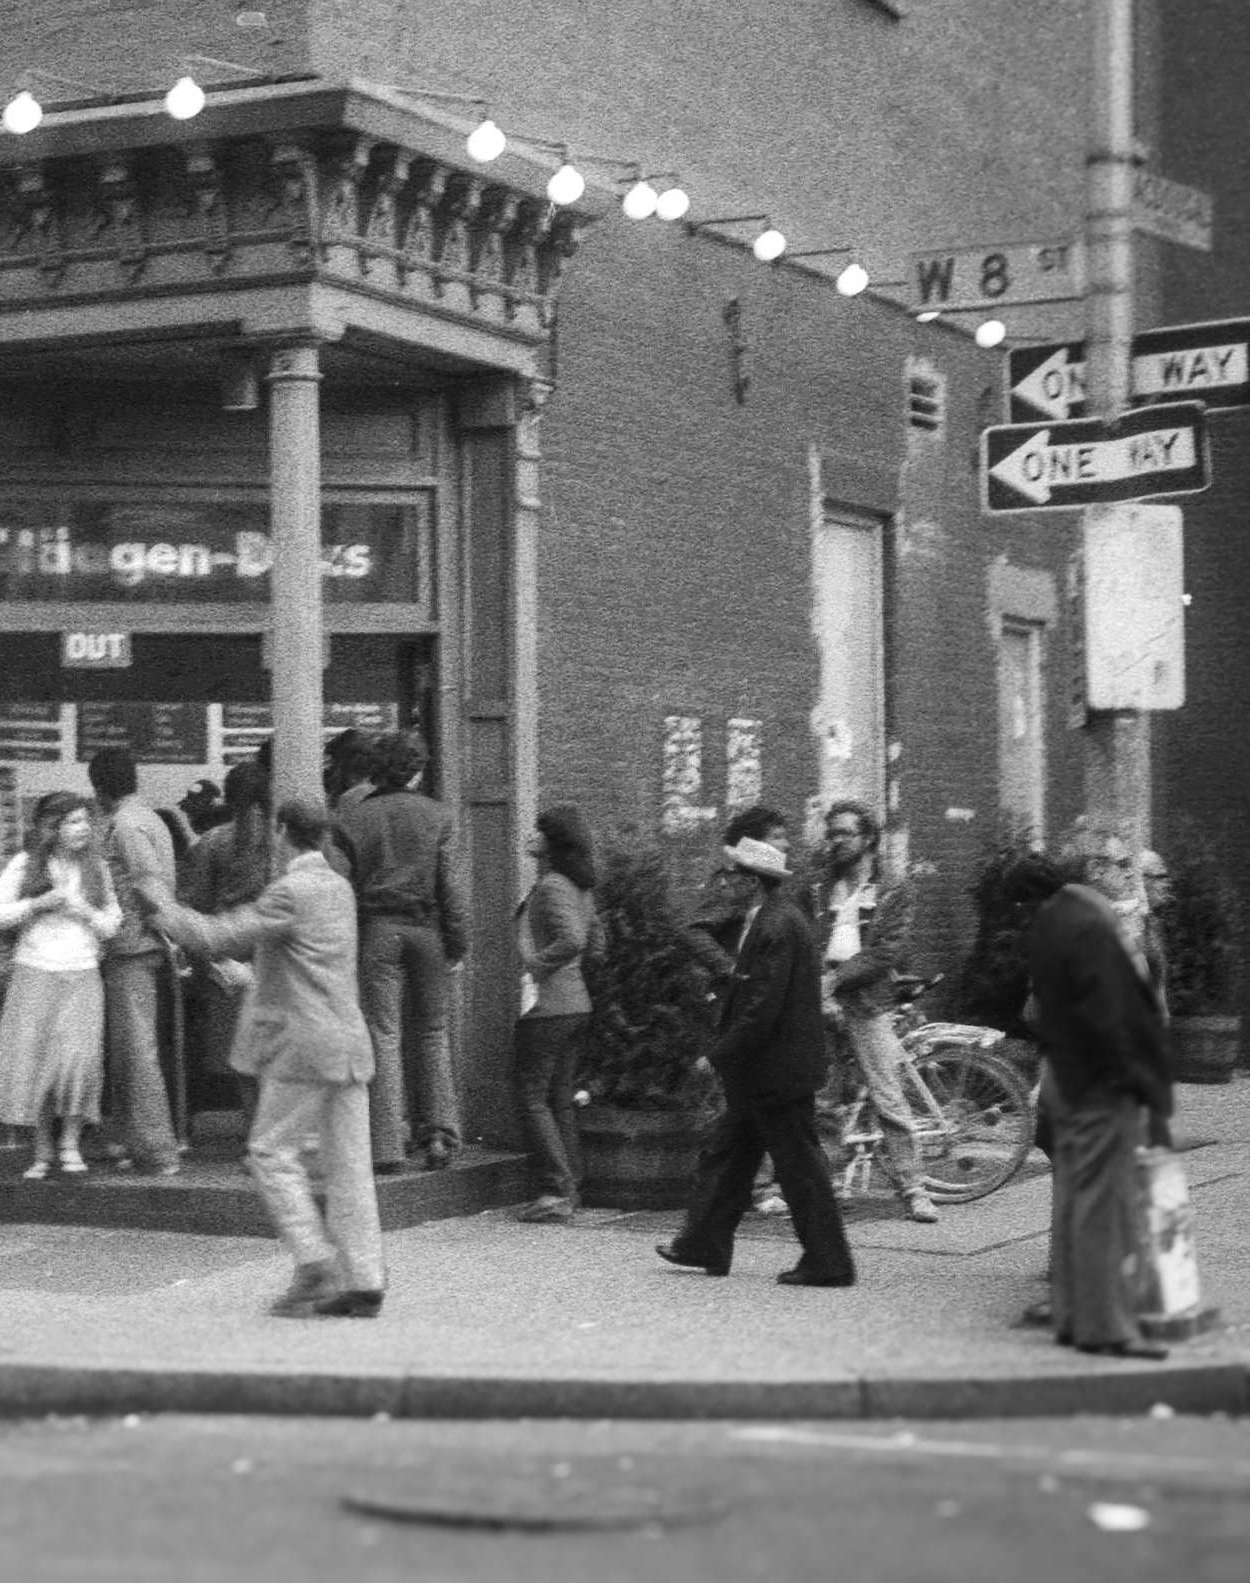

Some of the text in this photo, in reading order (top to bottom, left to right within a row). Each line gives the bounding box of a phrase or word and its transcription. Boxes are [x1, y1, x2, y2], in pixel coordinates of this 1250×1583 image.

[917, 257, 954, 300] W
[981, 253, 1008, 298] 8
[1162, 350, 1235, 386] WAY
[1022, 447, 1096, 483] ONE
[66, 632, 126, 659] OUT
